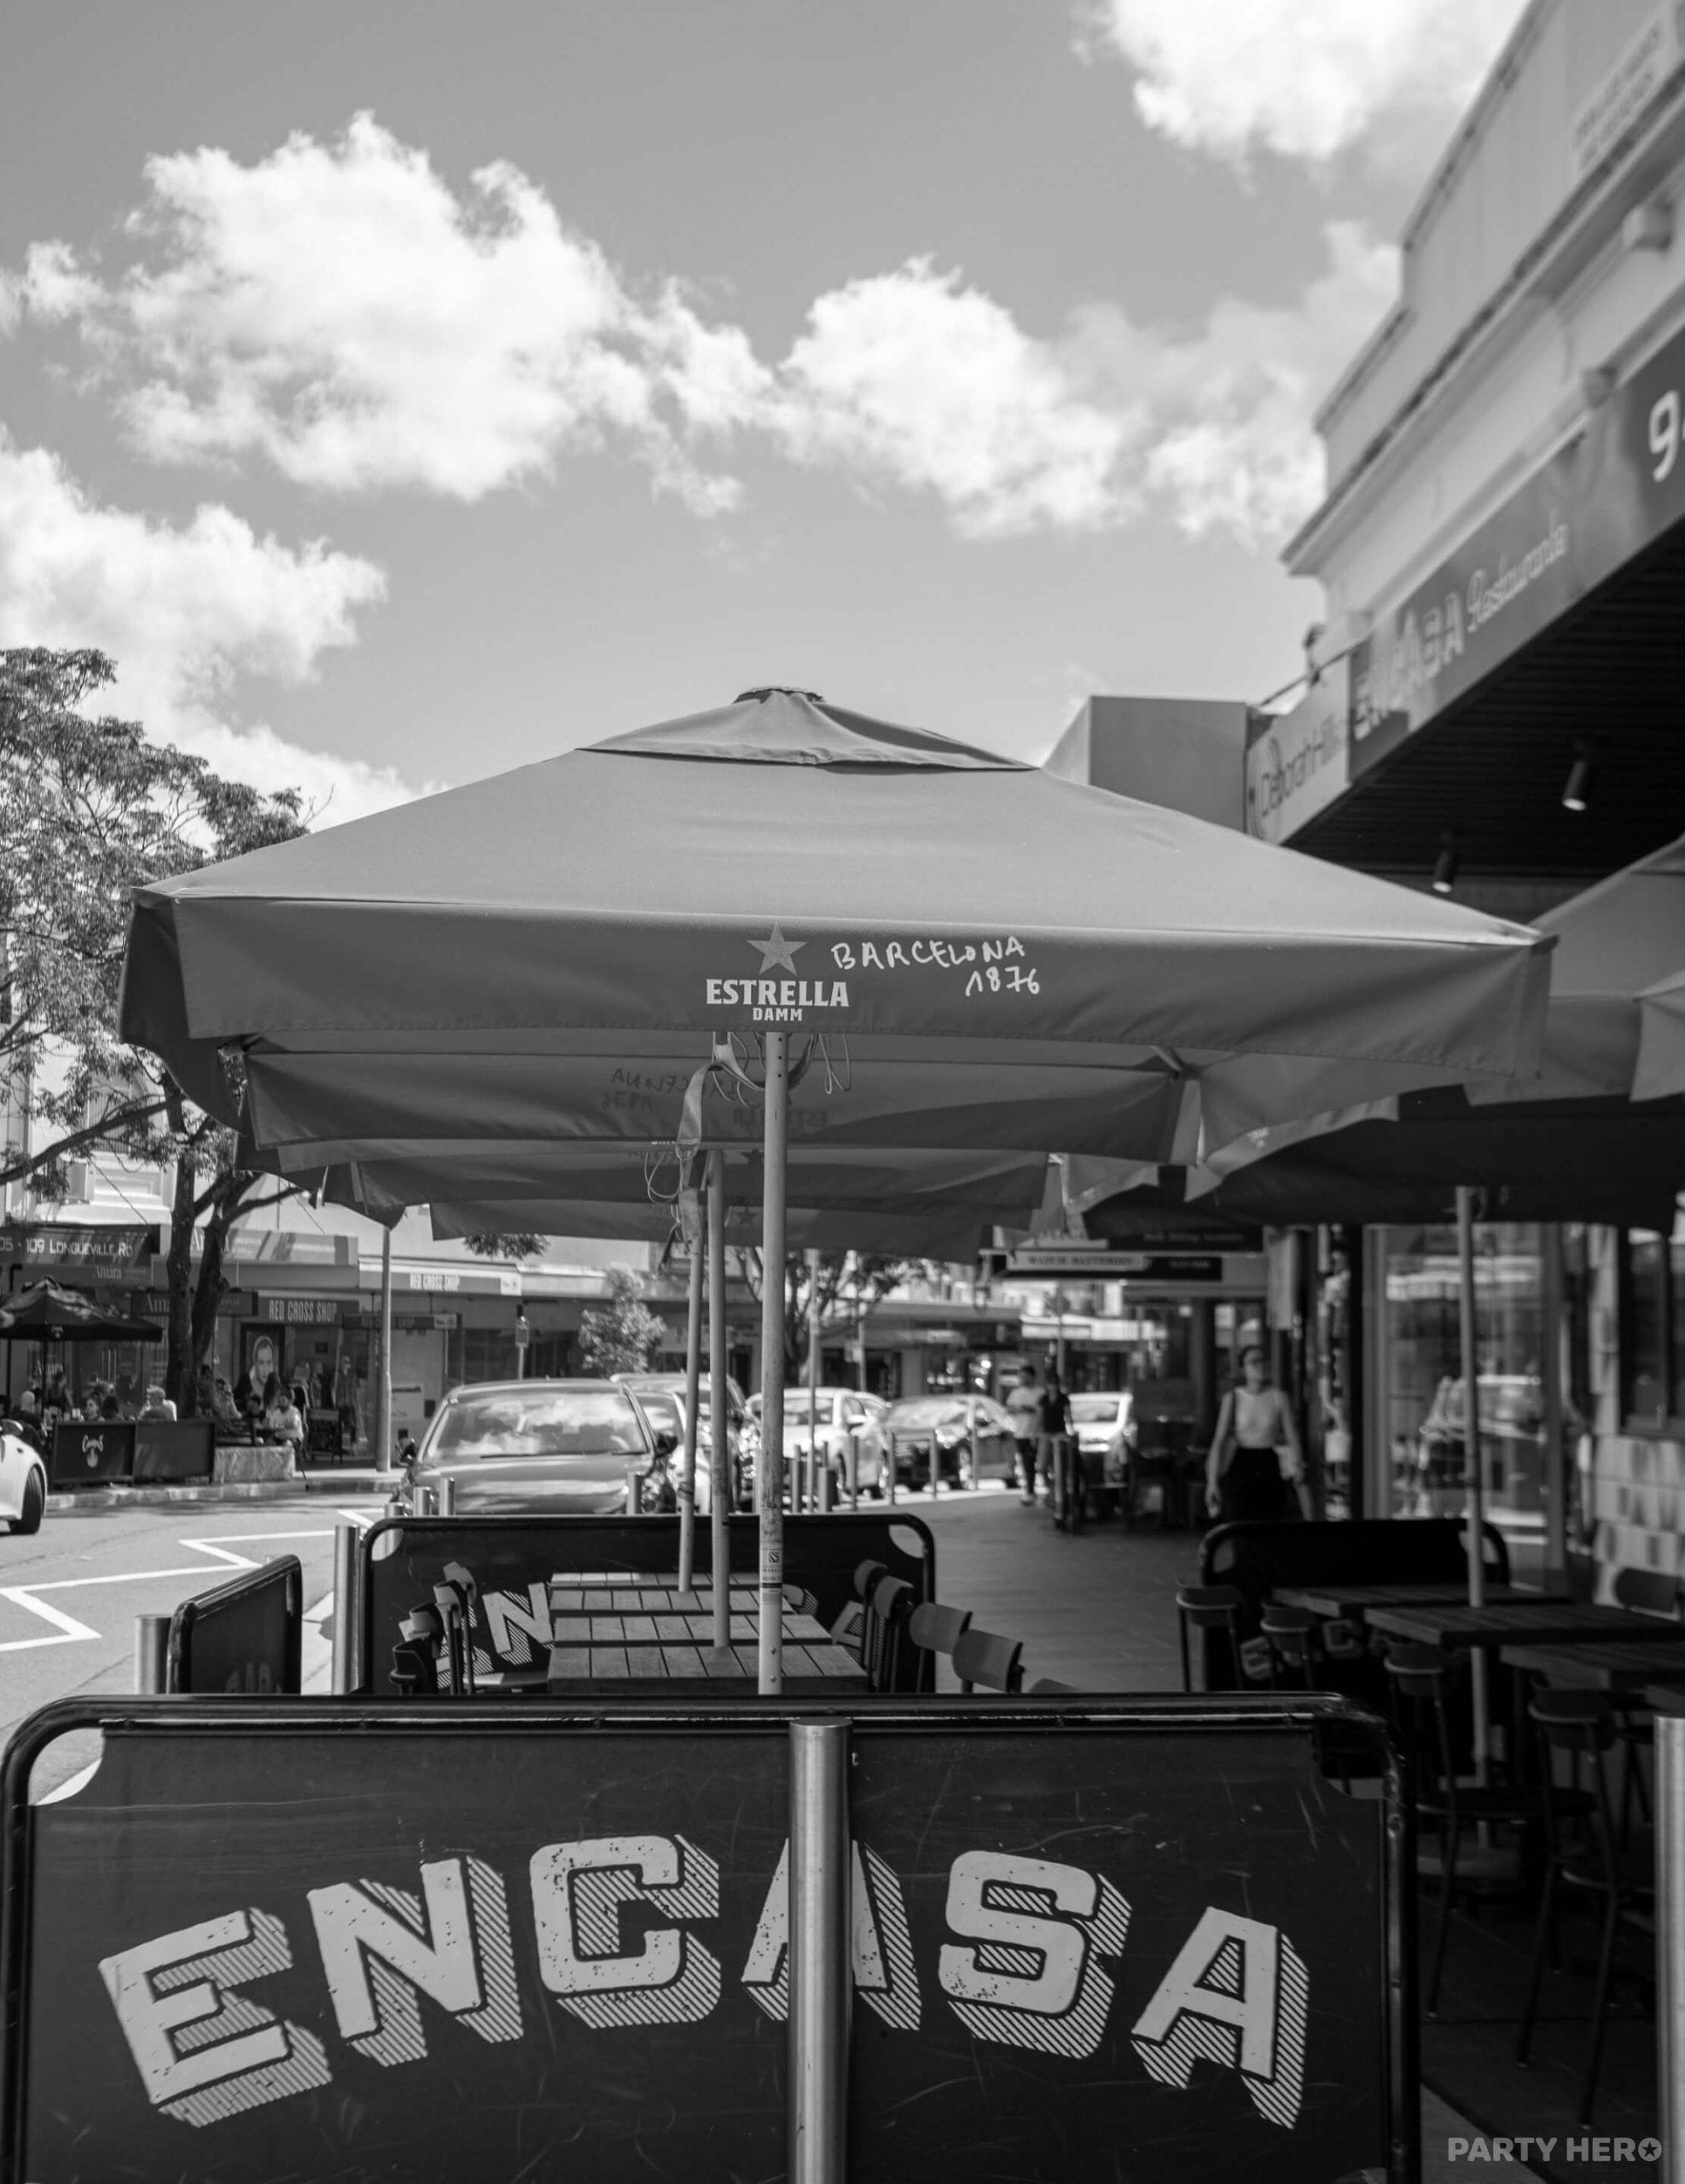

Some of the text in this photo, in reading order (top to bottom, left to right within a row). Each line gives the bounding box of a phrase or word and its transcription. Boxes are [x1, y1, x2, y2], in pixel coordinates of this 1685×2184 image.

[1648, 389, 1685, 483] 9
[831, 936, 1026, 970] BARCELONA
[706, 979, 850, 1008] ESTRELLA
[965, 966, 1040, 996] 1876
[752, 1008, 803, 1021] DAMM
[26, 1239, 45, 1253] 109
[269, 1299, 284, 1321] RED
[288, 1300, 314, 1322] CROSS
[317, 1301, 337, 1323] SHOP
